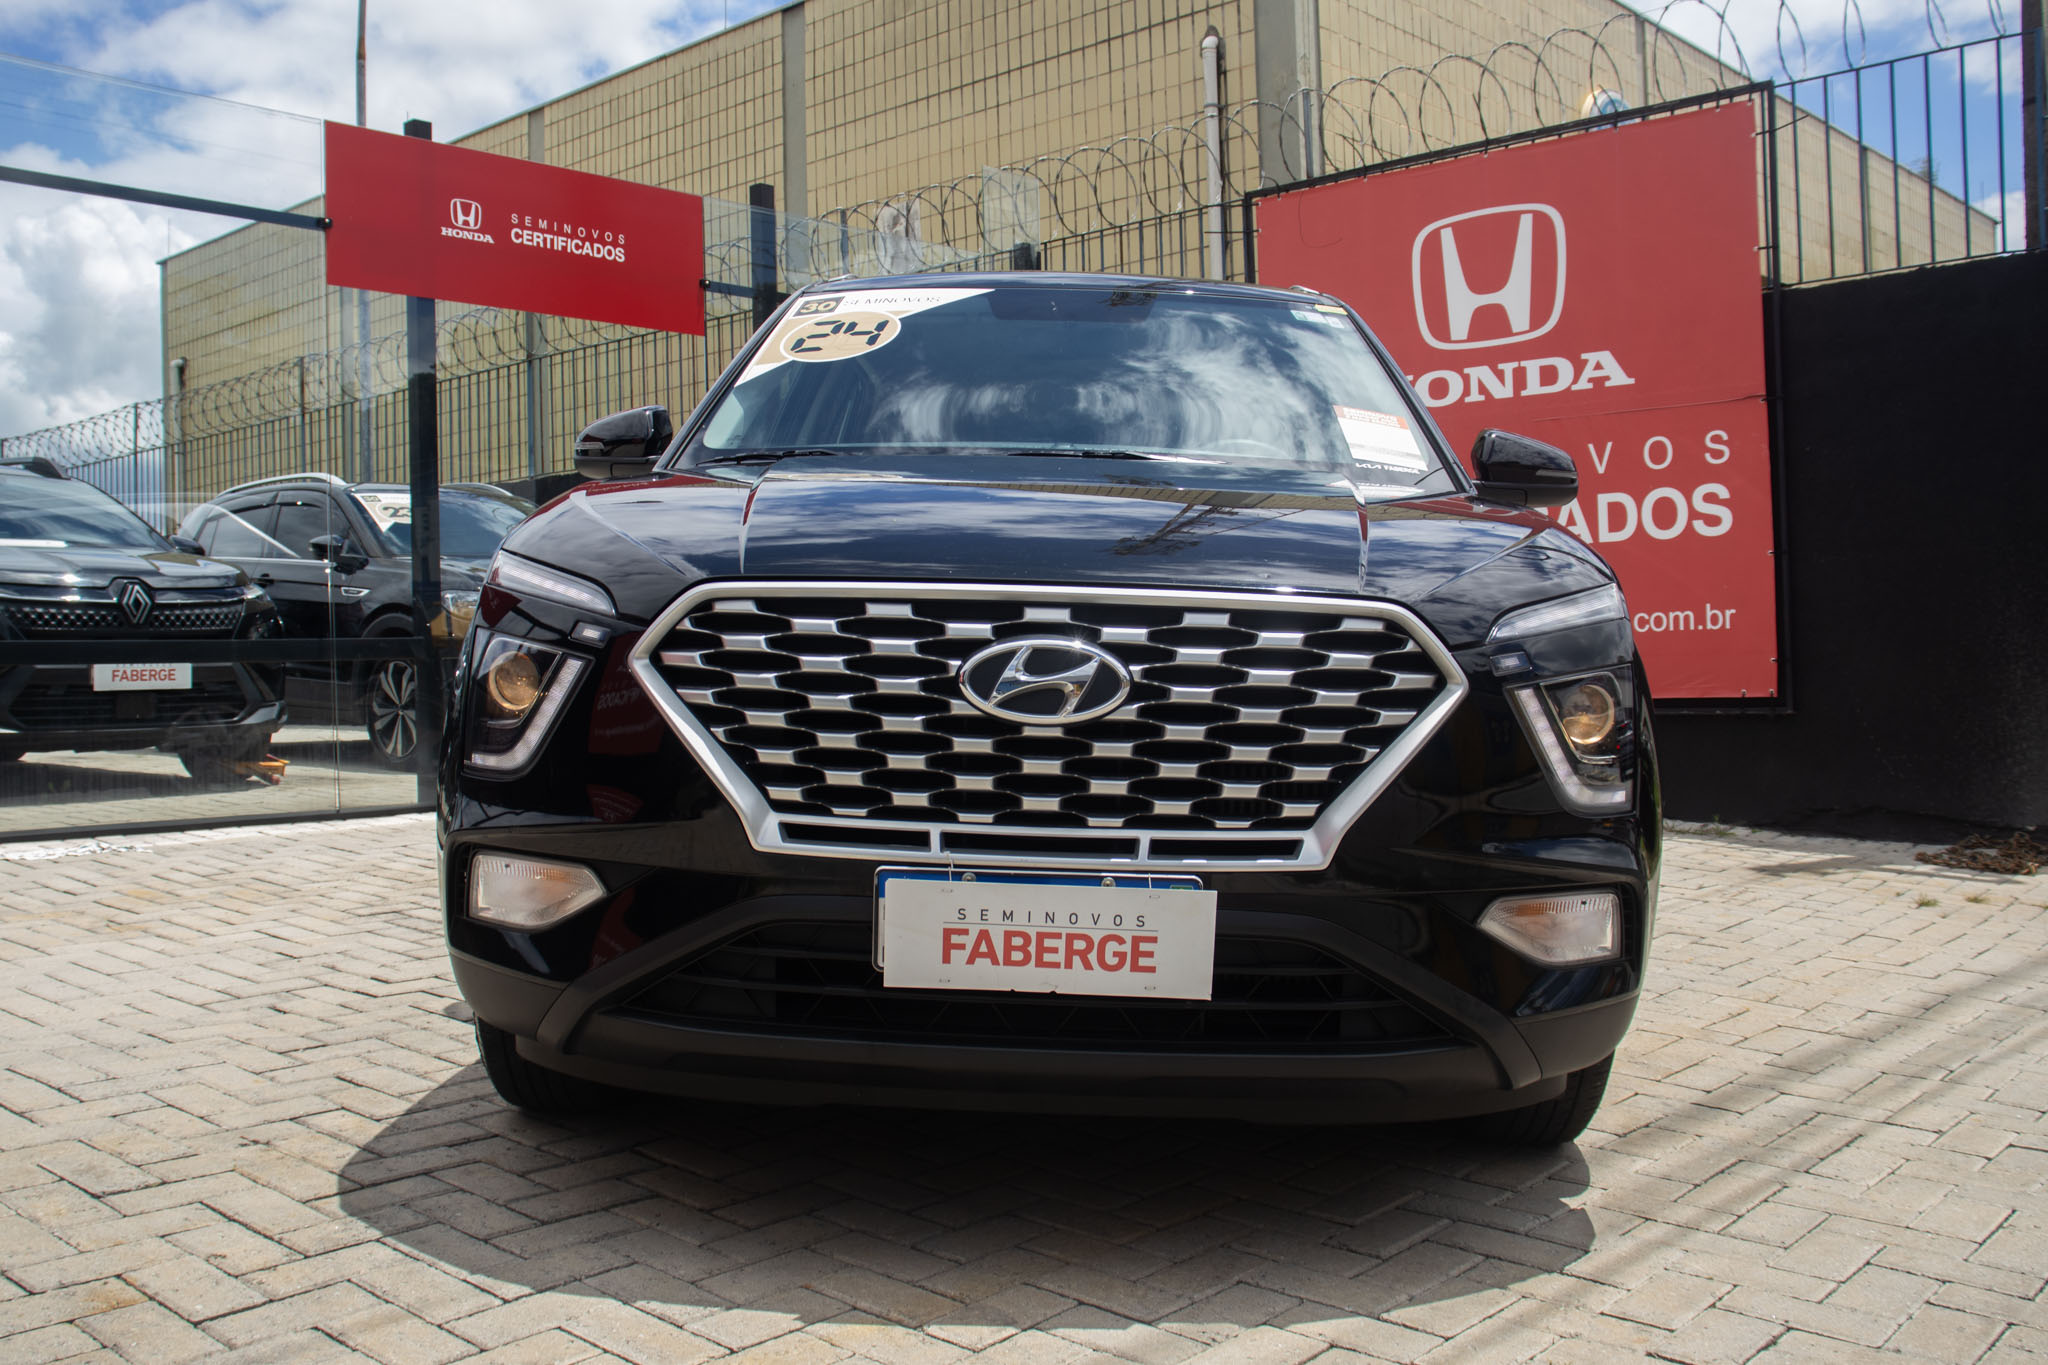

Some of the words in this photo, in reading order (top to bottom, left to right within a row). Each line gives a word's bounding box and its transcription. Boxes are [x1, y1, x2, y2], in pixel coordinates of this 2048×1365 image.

[440, 226, 495, 244] HONDA
[510, 228, 626, 263] CERTIFICADOS
[511, 213, 626, 245] SEMINOVOS
[790, 319, 890, 354] 24
[1405, 350, 1636, 408] ONDA
[1534, 482, 1734, 546] ADOS
[111, 668, 177, 682] FABERGE
[957, 908, 1146, 927] SEMINOVOS
[941, 927, 1159, 973] FABERGE
